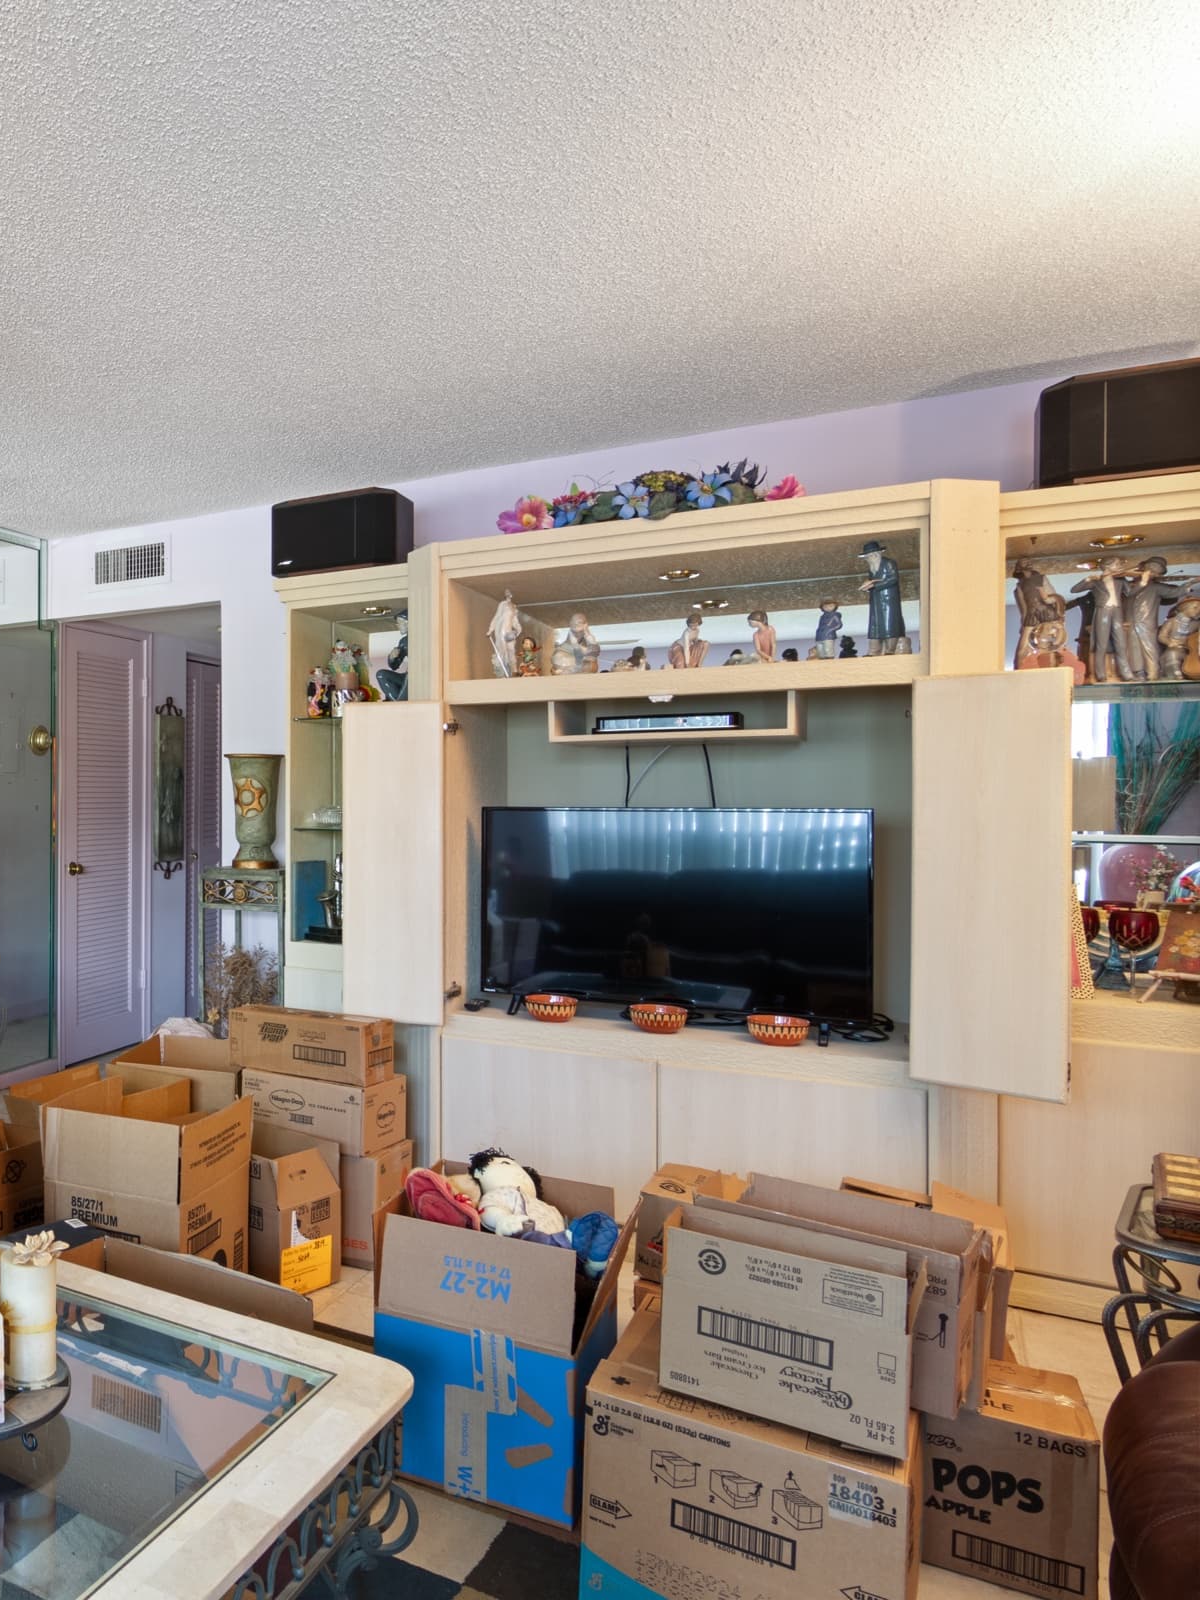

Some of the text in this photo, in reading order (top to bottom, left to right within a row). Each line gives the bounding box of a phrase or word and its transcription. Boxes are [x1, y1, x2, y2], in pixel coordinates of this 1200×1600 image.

[71, 1195, 104, 1212] 85/27/1
[71, 1207, 118, 1228] PREMIUM
[187, 1210, 213, 1234] PREMIUM
[439, 1270, 512, 1305] M2-27
[703, 1350, 766, 1373] Ice Cream Bars
[709, 1360, 759, 1381] Cheesecake
[779, 1366, 832, 1392] Factory
[777, 1379, 853, 1411] Cheesecake
[821, 1399, 834, 1410] The
[849, 1413, 896, 1434] 2.65 FL OZ
[698, 1432, 731, 1448] CARTONS
[866, 1429, 896, 1445] 5-4 PK
[1014, 1431, 1087, 1458] 12 BAGS
[931, 1457, 1044, 1514] POPS
[591, 1497, 621, 1514] CLAMP
[709, 1495, 716, 1504] 2
[829, 1483, 885, 1511] 18403
[771, 1516, 778, 1525] 3
[828, 1499, 897, 1528] GMI0018403
[924, 1495, 991, 1525] APPLE
